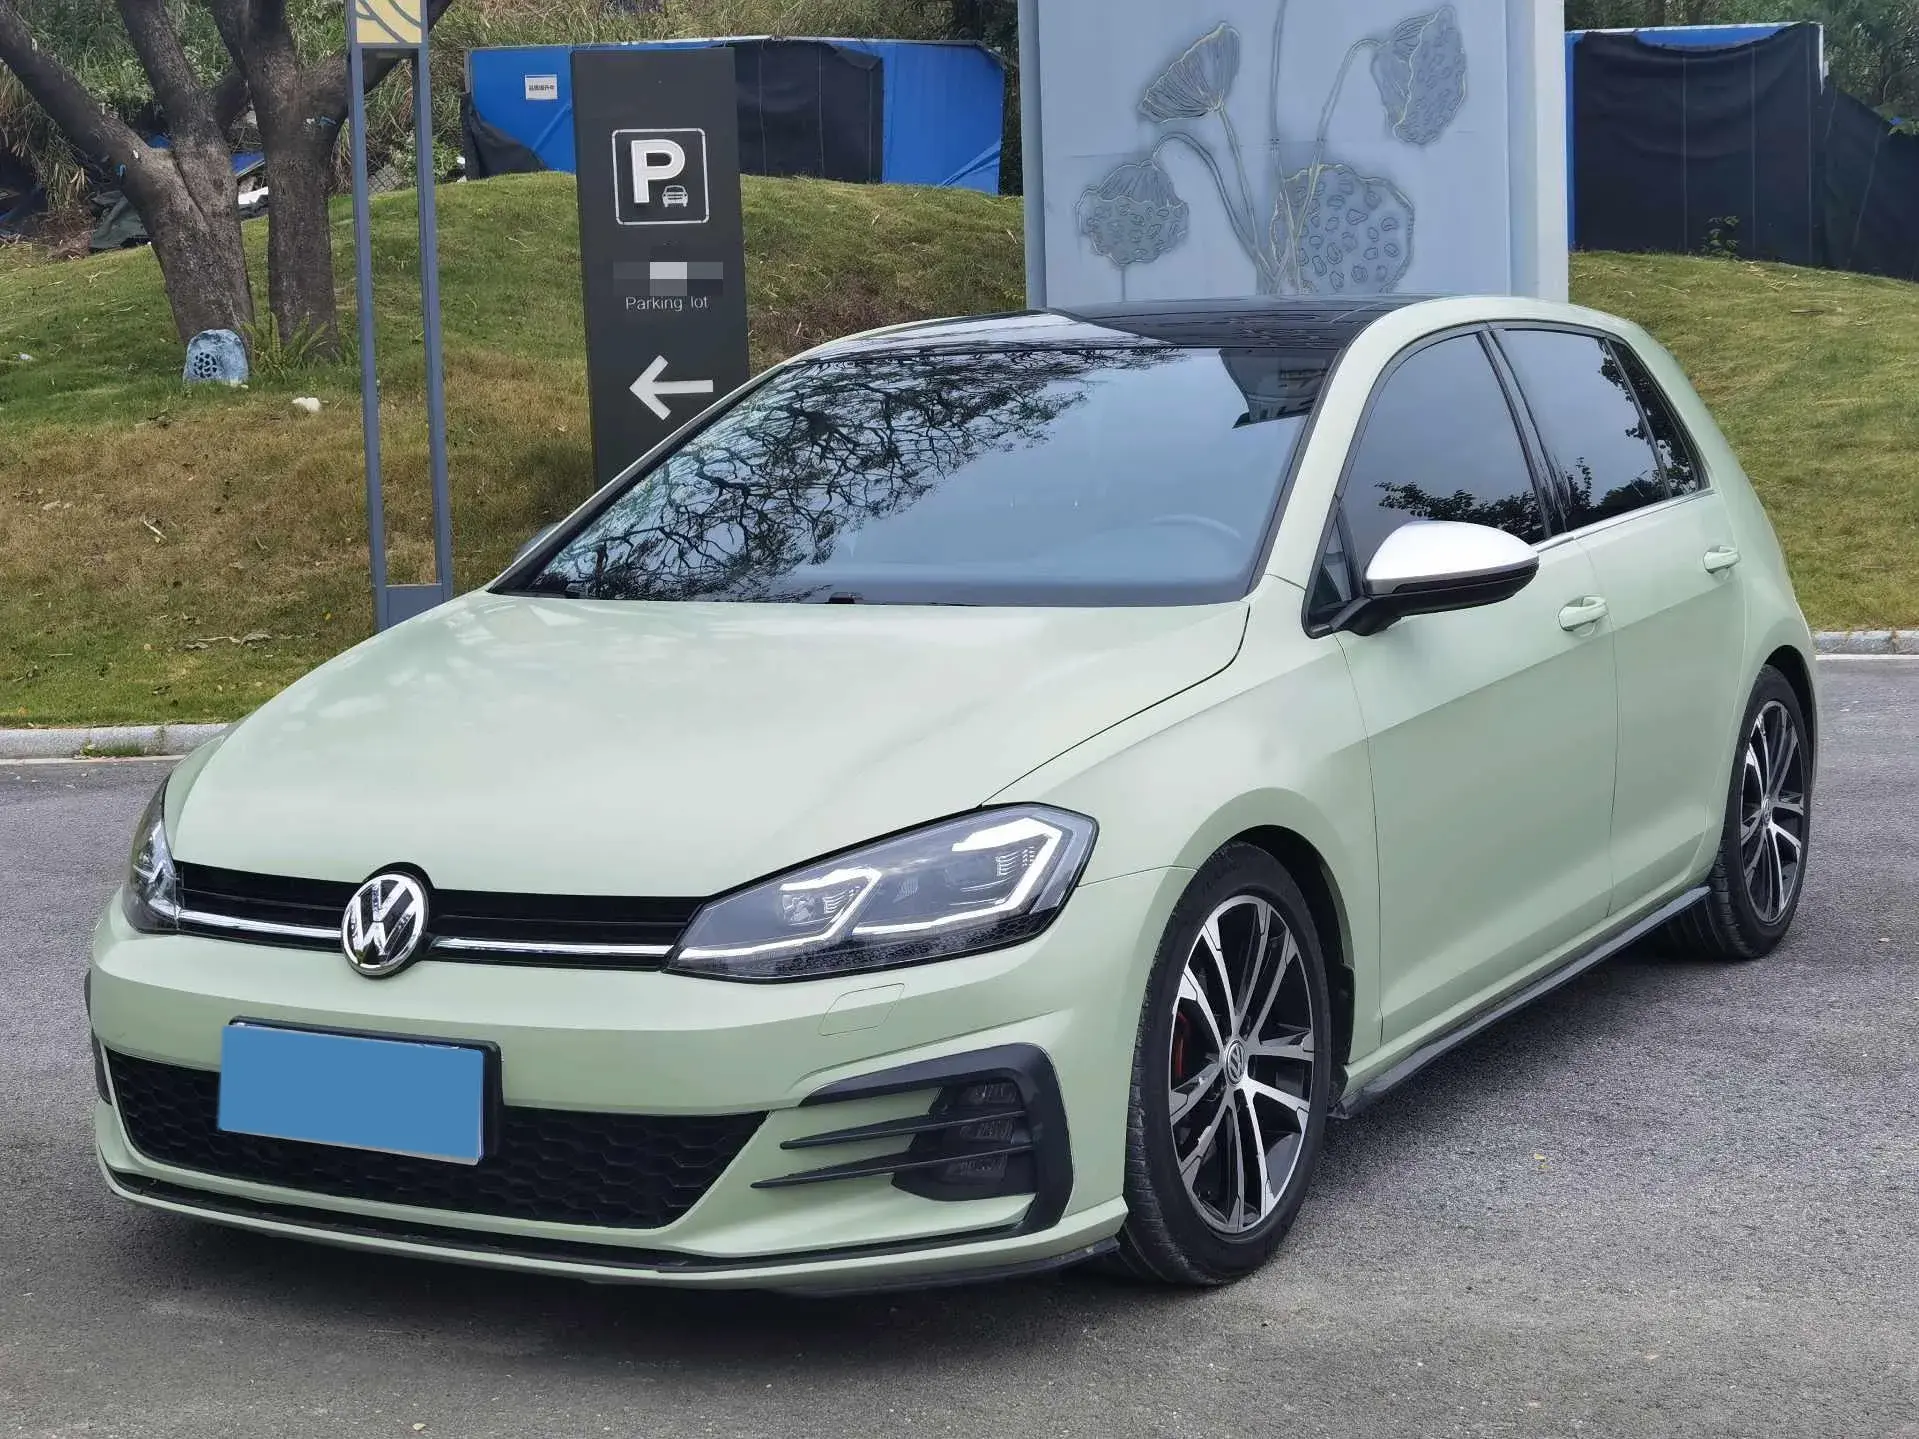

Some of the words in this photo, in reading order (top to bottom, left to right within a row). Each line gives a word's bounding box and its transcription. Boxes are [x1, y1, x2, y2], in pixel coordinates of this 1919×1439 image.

[631, 139, 686, 203] P
[625, 296, 683, 312] Parking
[690, 296, 709, 309] lot
